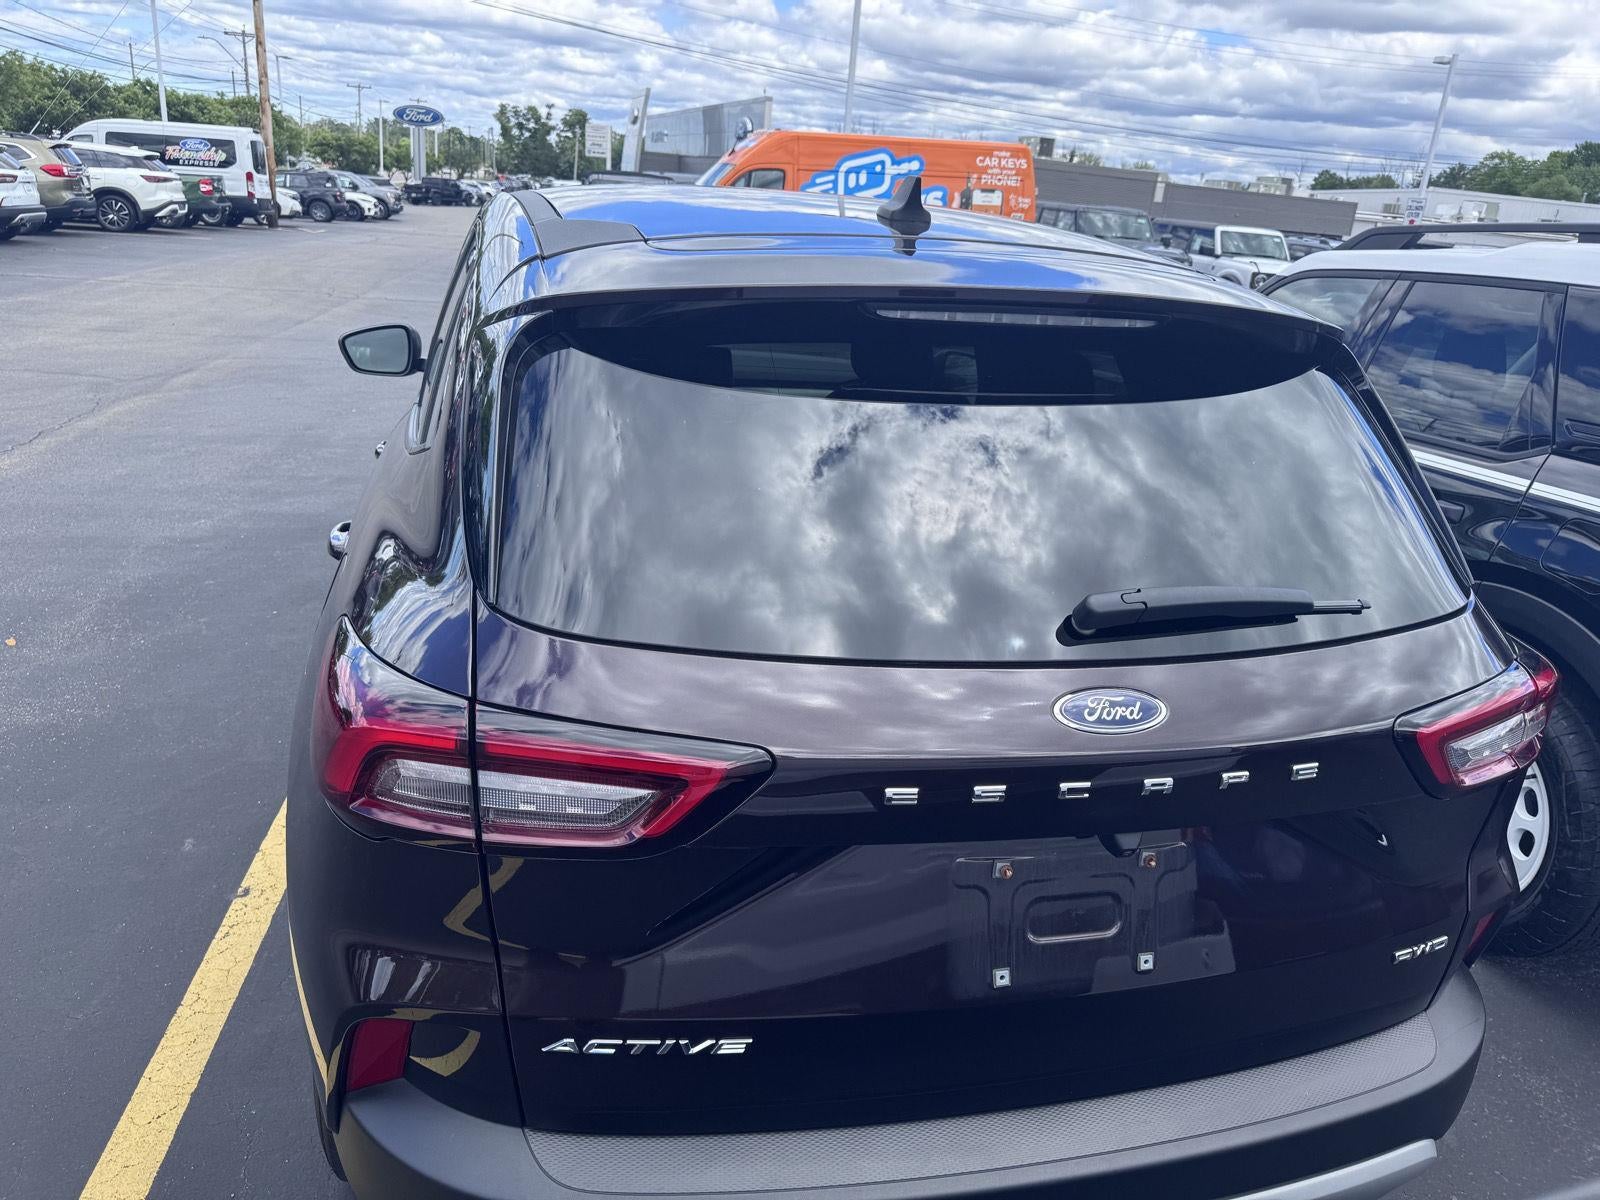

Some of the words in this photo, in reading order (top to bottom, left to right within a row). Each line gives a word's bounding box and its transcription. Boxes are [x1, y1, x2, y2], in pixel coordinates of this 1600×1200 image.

[403, 107, 434, 122] Ford
[179, 159, 214, 167] EXPRESS
[976, 156, 999, 168] CAR
[1001, 158, 1028, 169] KEYS
[981, 174, 1021, 186] PHONE!
[1083, 695, 1143, 722] Ford
[884, 762, 1319, 806] ESCAPE
[541, 1038, 753, 1055] ACTIVE
